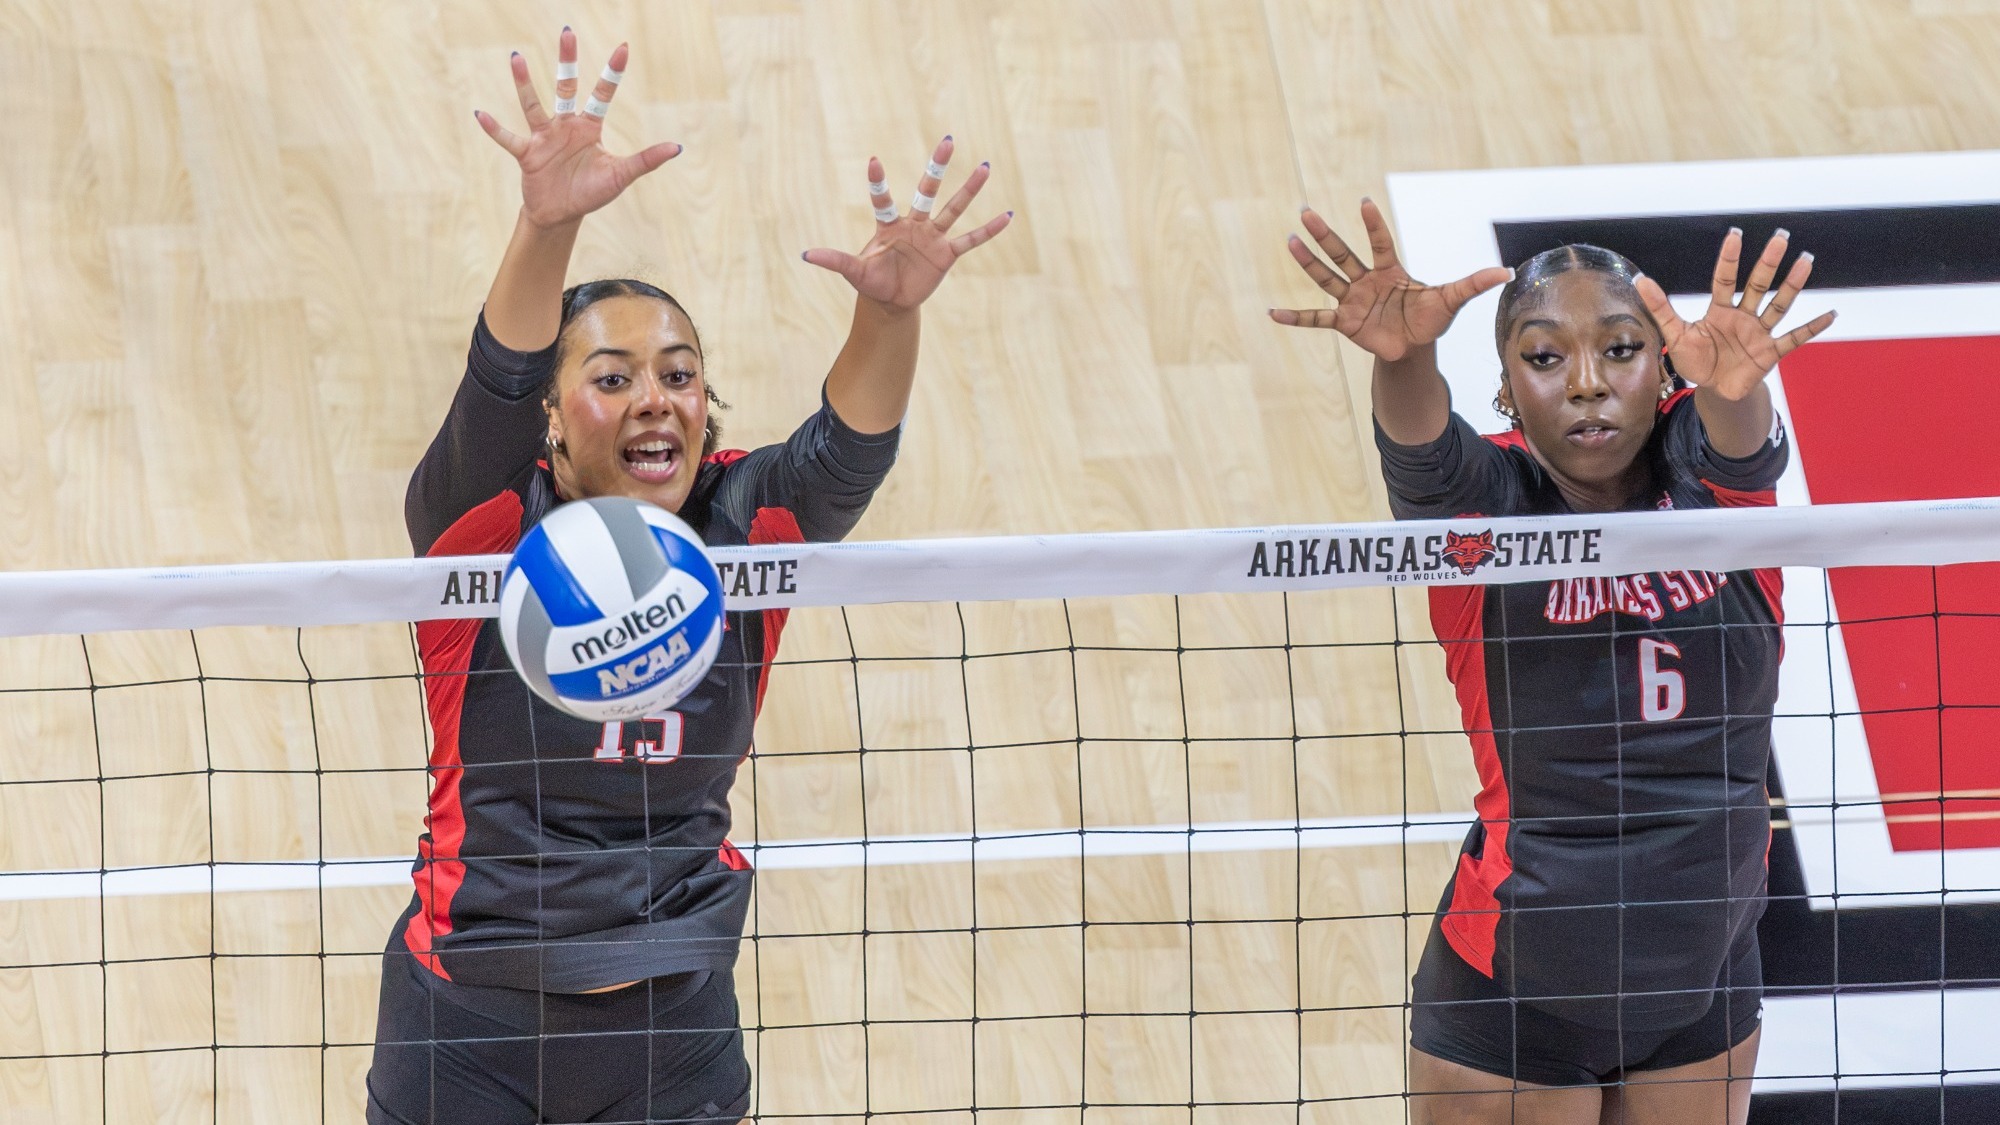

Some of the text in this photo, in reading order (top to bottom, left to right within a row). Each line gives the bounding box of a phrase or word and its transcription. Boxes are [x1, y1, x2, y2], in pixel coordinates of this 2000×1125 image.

[715, 560, 798, 597] TATE
[1247, 529, 1602, 577] ARKANSAS STATE
[1386, 572, 1457, 582] RED WOLVES
[571, 593, 686, 664] molten
[596, 630, 692, 698] NCAA
[1638, 636, 1687, 722] 6
